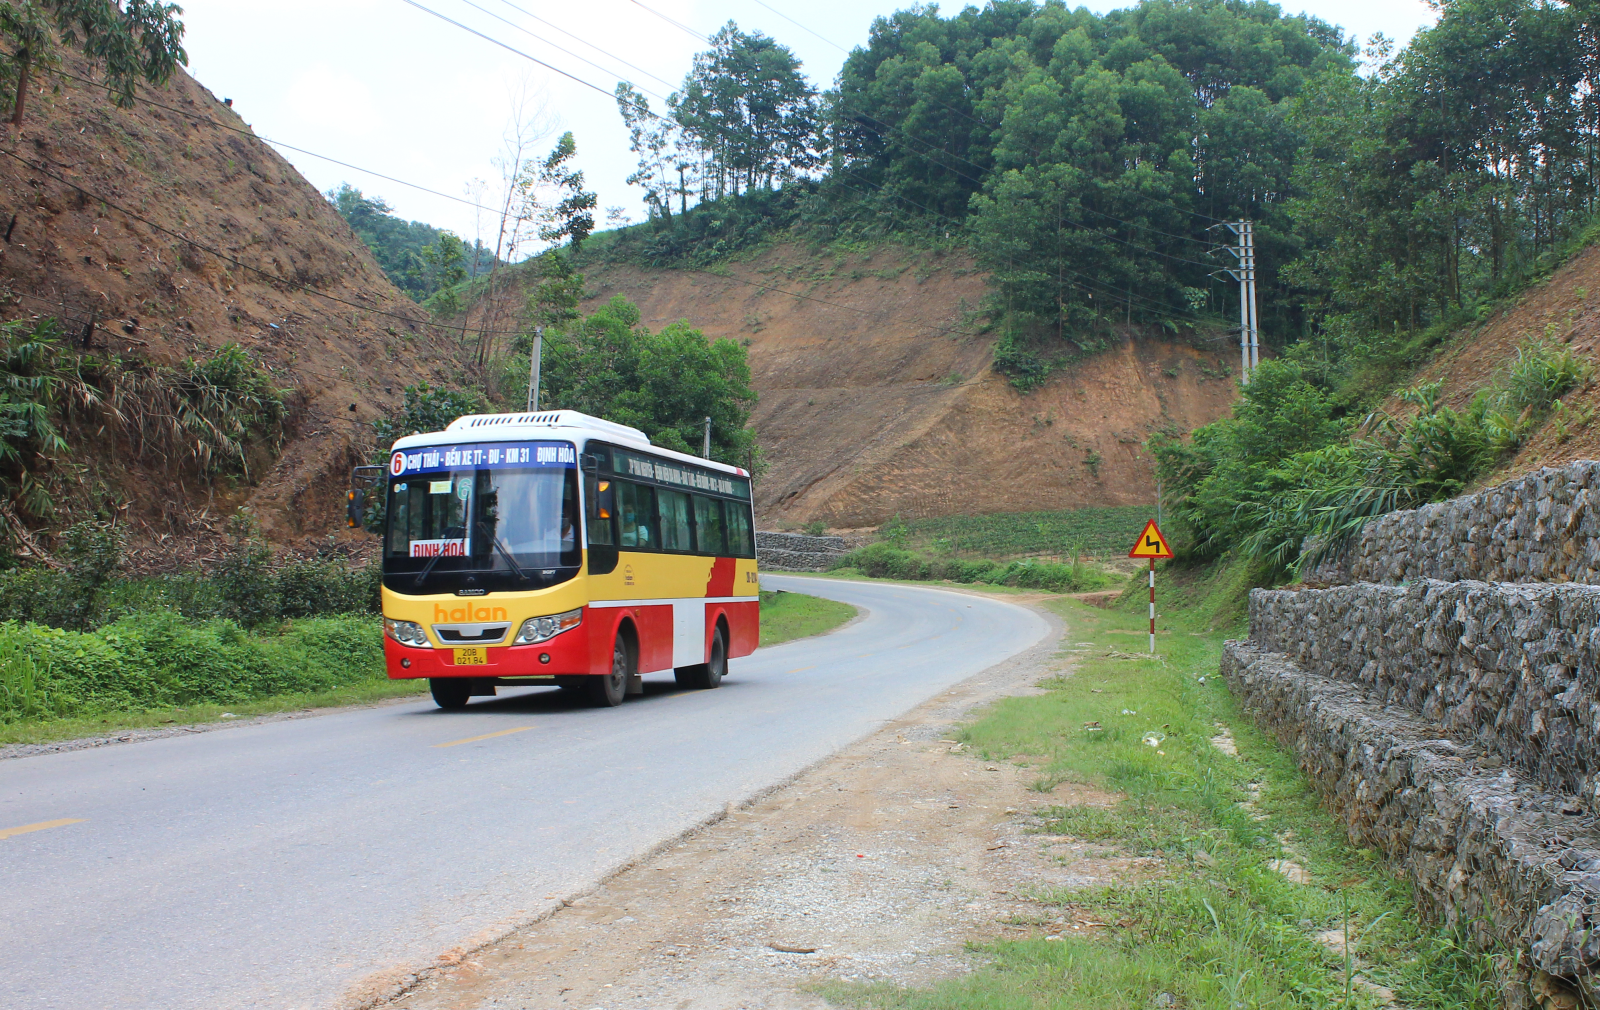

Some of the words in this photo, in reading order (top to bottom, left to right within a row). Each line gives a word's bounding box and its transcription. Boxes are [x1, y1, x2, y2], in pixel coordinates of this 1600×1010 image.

[394, 453, 403, 474] 6
[407, 452, 423, 472] CHỢ
[423, 449, 440, 468] THÁI
[444, 447, 461, 467] BẾN
[461, 450, 472, 466] XE
[474, 449, 483, 465] TT
[505, 447, 519, 464] KM
[520, 447, 530, 463] 31
[537, 446, 557, 465] ĐỊNH
[457, 478, 472, 501] 6
[434, 602, 508, 622] halan
[462, 648, 477, 657] 20B
